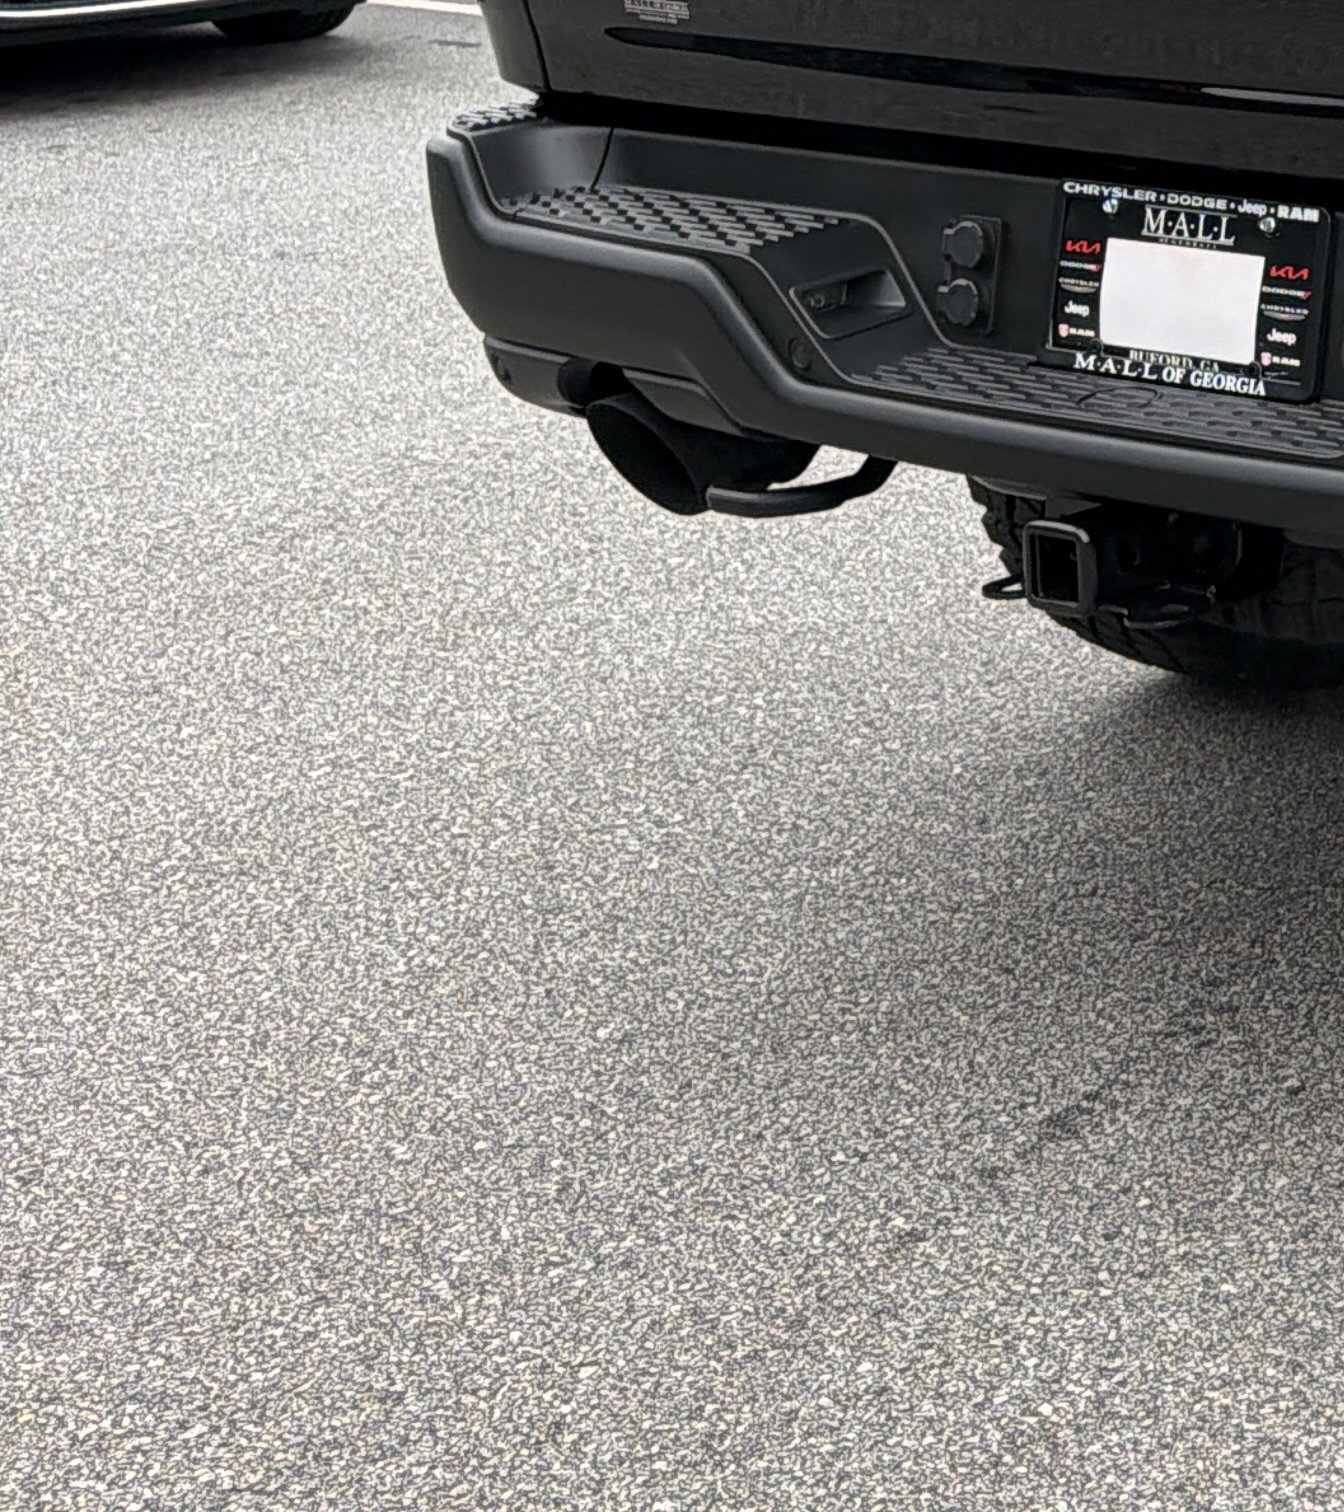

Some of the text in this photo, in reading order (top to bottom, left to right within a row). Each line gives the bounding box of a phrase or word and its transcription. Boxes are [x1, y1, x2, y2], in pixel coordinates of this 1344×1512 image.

[1063, 181, 1320, 223] CHRYSLER DODGE Jeep RAM
[1064, 300, 1090, 318] Jeep
[1266, 328, 1297, 346] Jeep
[1162, 366, 1186, 384] OF
[1190, 371, 1267, 396] GEORGIA
